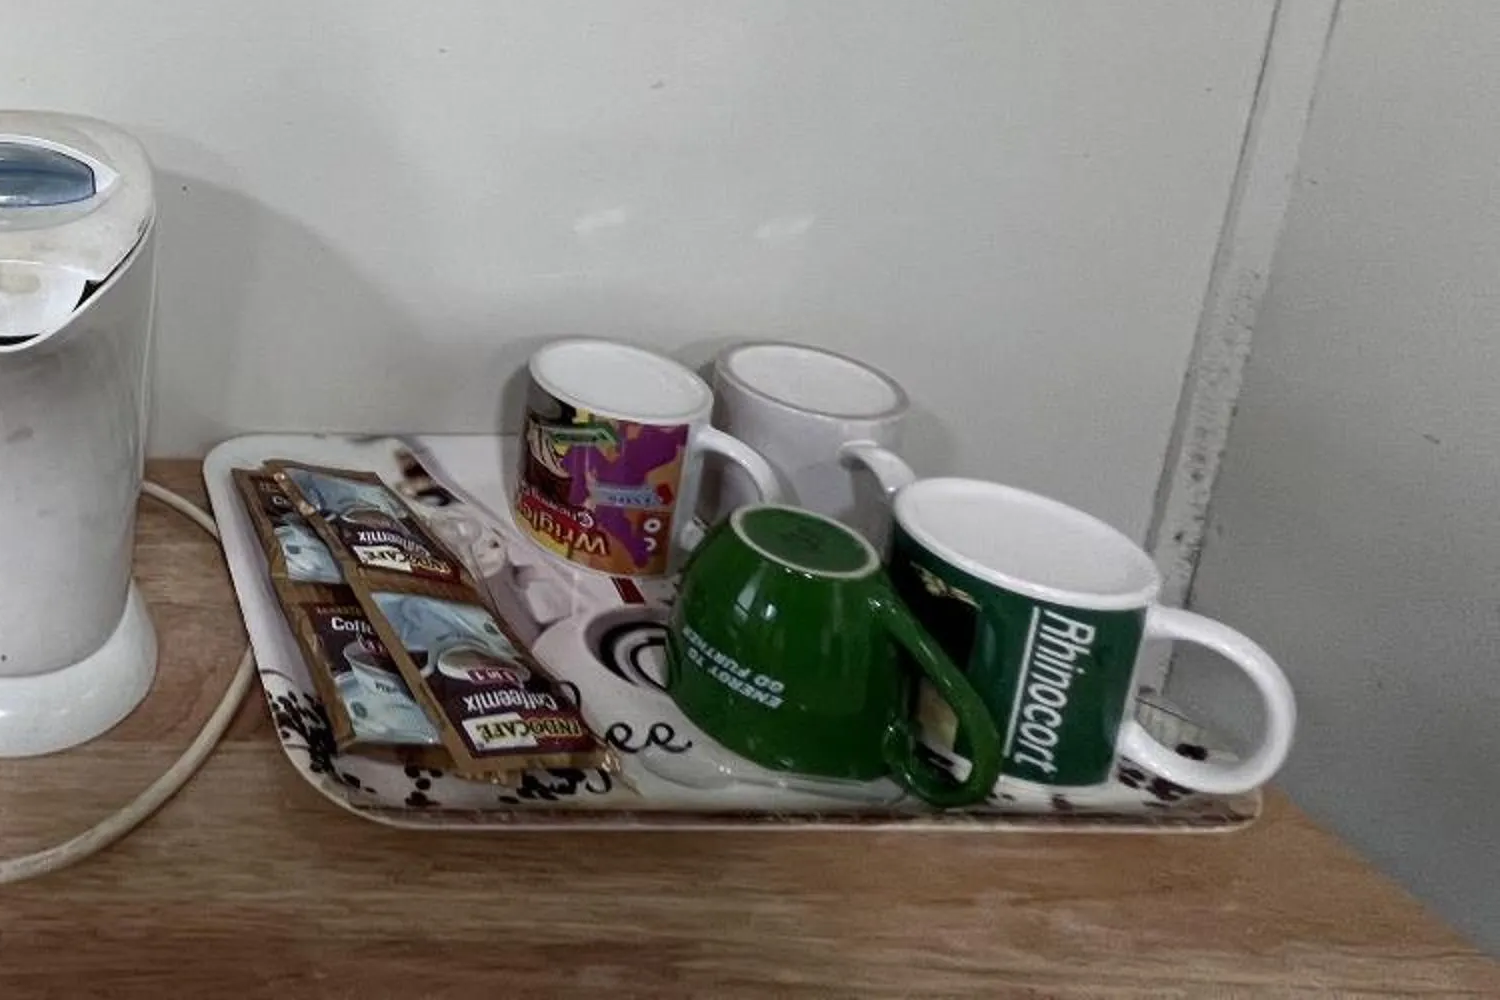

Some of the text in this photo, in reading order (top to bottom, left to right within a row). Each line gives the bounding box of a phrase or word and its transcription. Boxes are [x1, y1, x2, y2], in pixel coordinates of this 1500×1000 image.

[706, 665, 784, 708] ENERGY
[754, 674, 785, 694] GO
[1014, 609, 1096, 773] Rhinocort
[462, 689, 559, 714] Coffeemix
